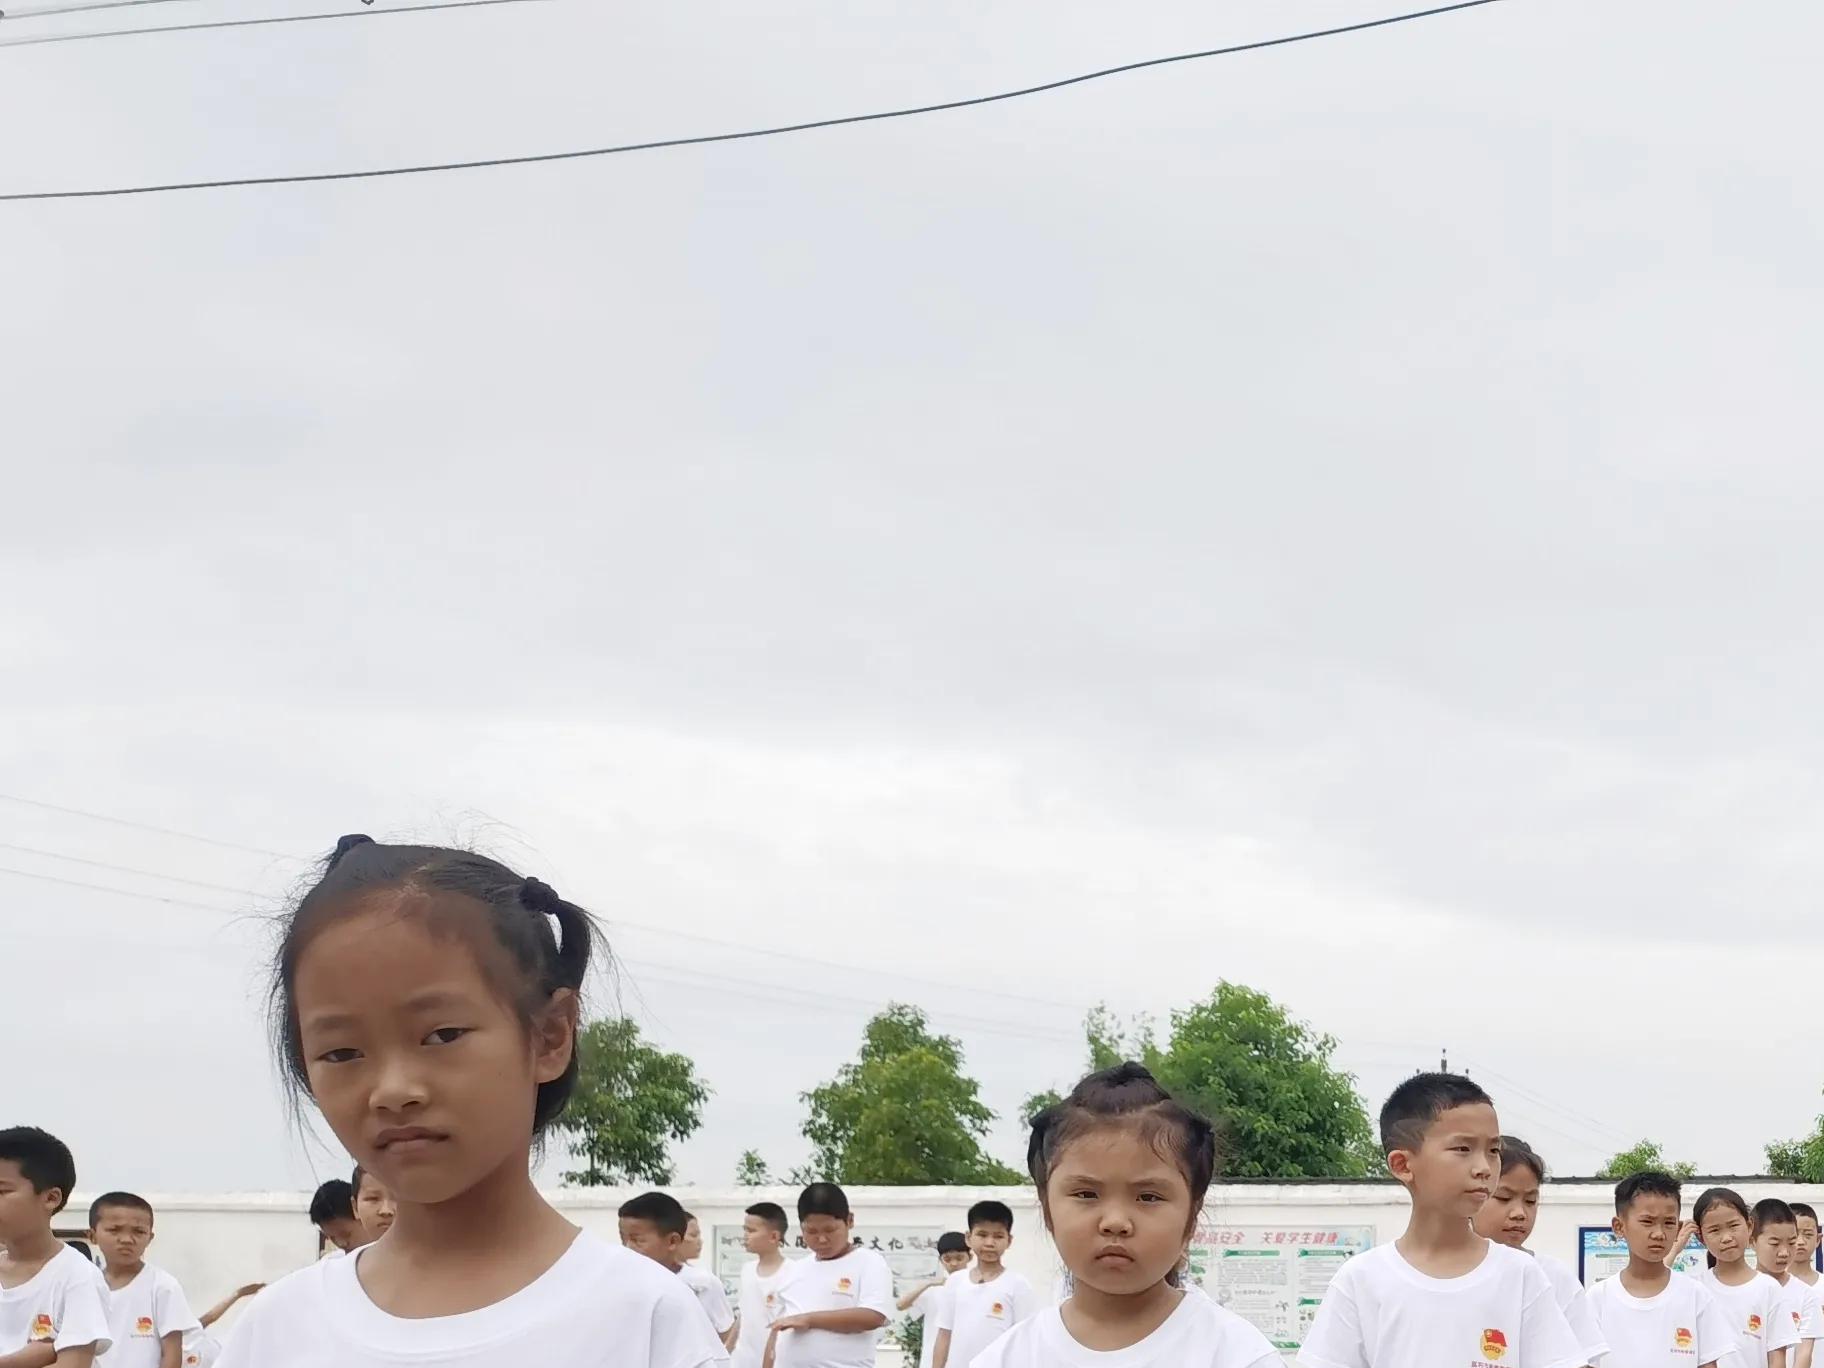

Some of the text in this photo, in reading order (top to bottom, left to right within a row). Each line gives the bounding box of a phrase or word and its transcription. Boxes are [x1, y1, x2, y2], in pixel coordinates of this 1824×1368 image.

[1262, 1231, 1339, 1245] 关爱学生健康
